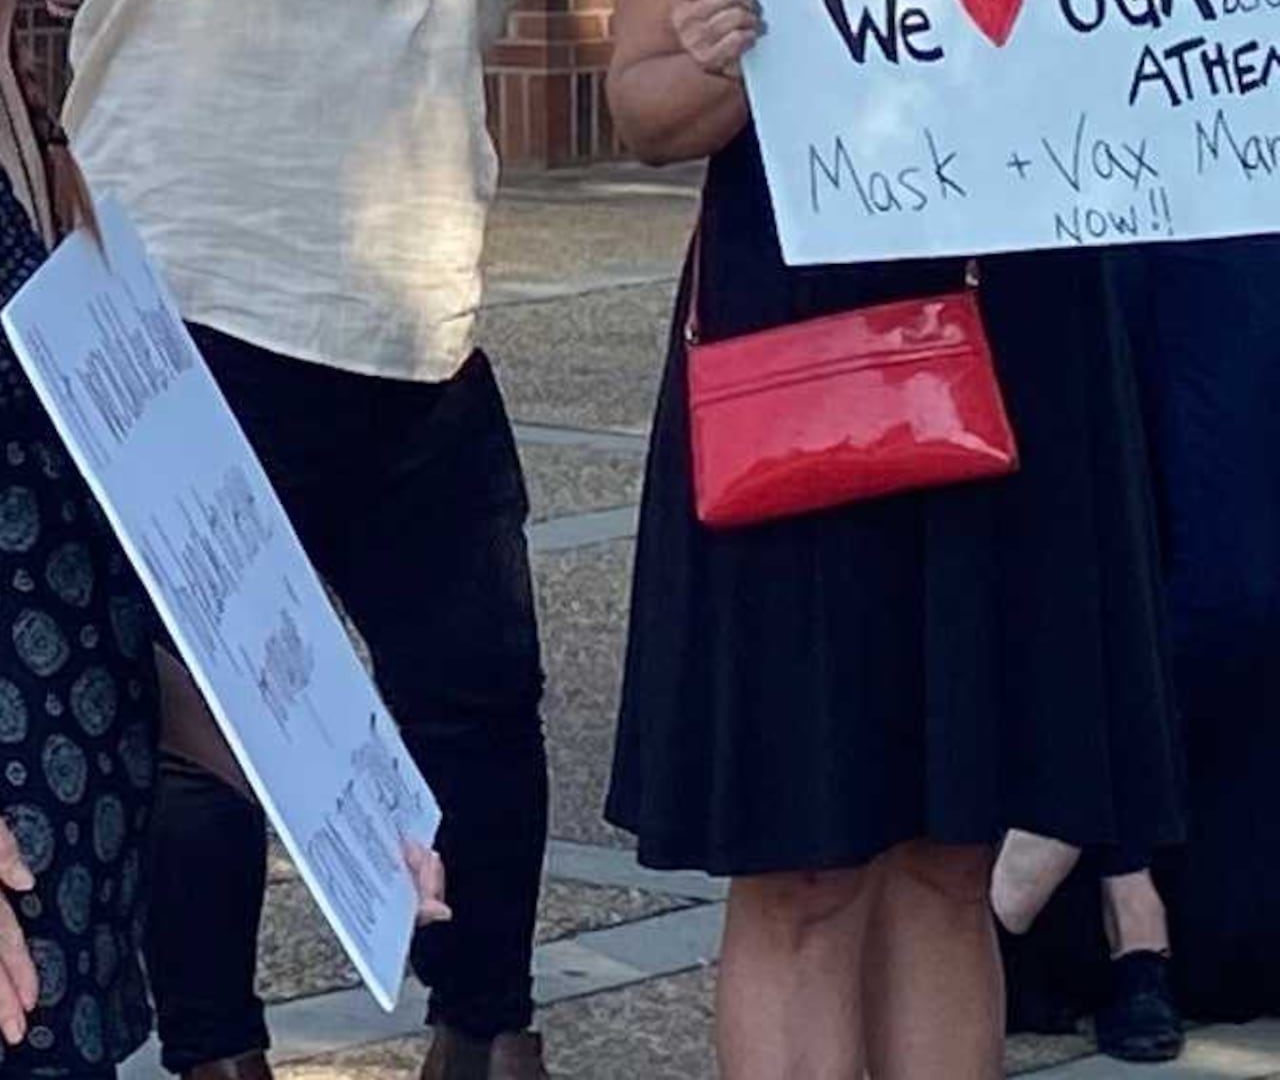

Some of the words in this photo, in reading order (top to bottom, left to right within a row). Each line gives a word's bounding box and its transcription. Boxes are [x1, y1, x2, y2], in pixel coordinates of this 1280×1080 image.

[808, 128, 968, 216] Mask
[1043, 112, 1160, 194] Vax
[1053, 187, 1176, 244] NOW!!
